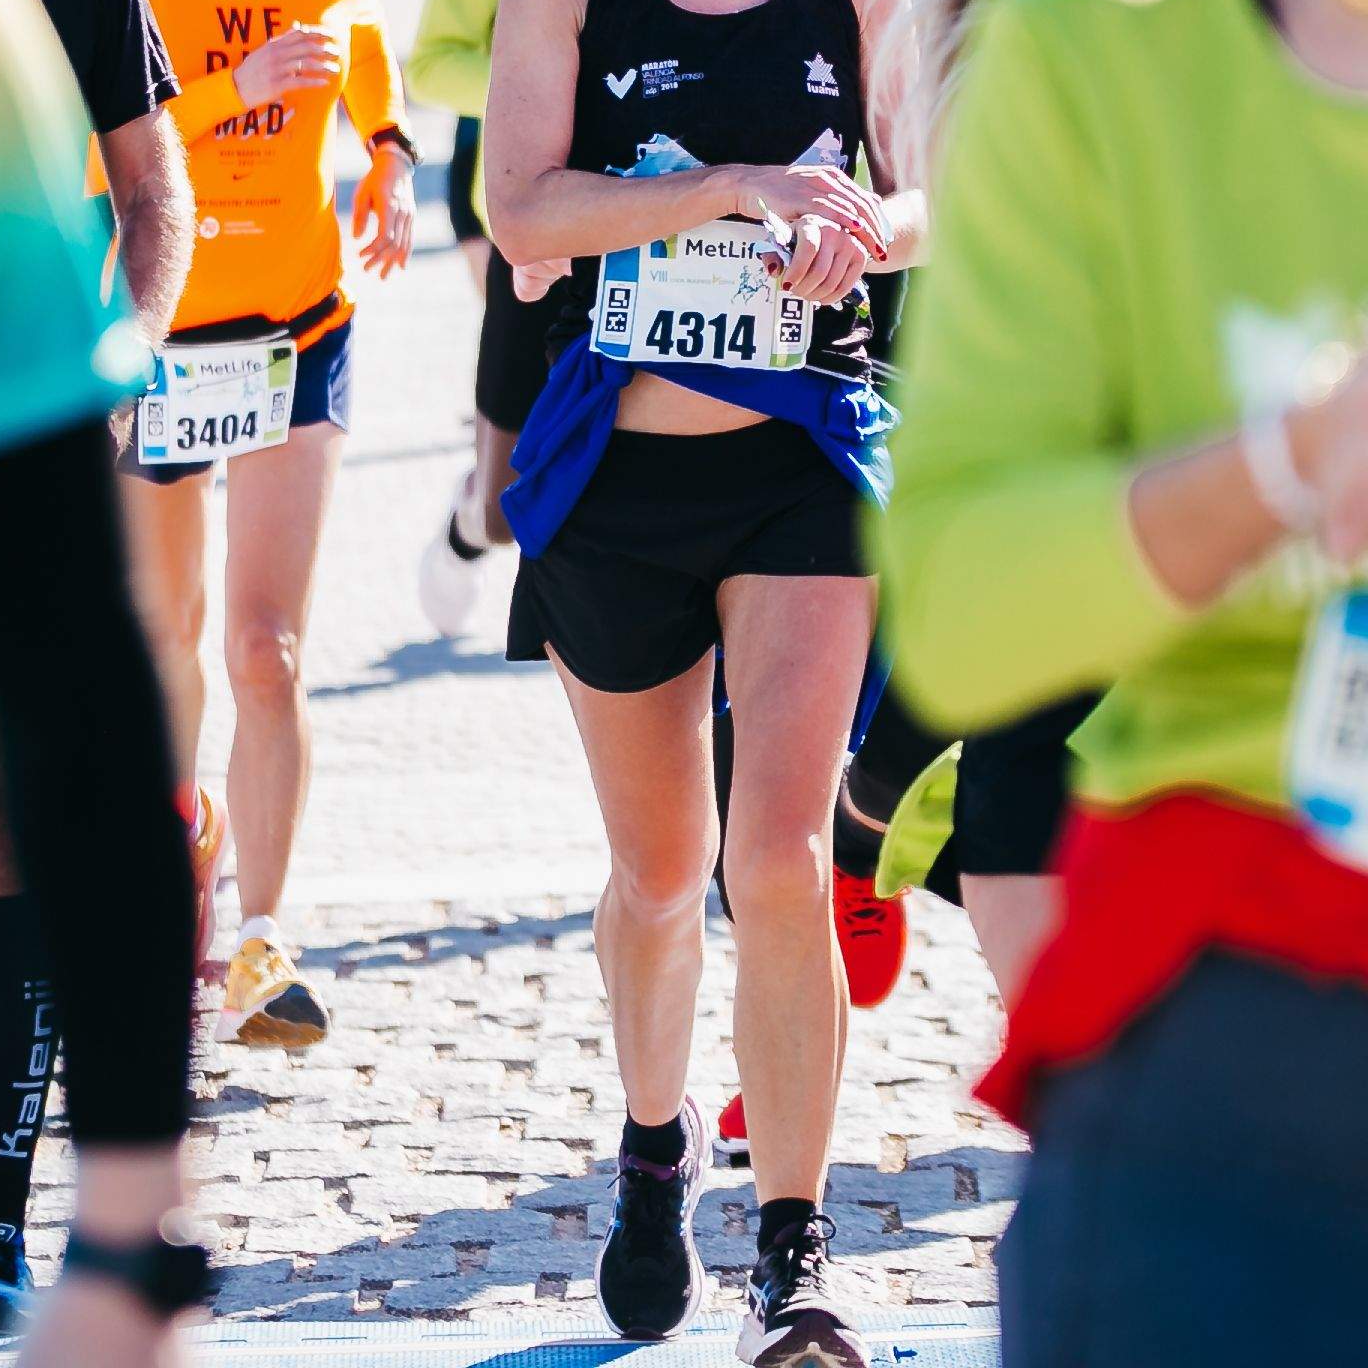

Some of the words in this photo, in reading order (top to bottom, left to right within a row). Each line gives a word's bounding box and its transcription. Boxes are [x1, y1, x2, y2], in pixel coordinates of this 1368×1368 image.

[685, 238, 763, 260] MetLif
[646, 309, 757, 360] 4314
[200, 359, 262, 376] MetLife
[177, 410, 259, 450] 3404
